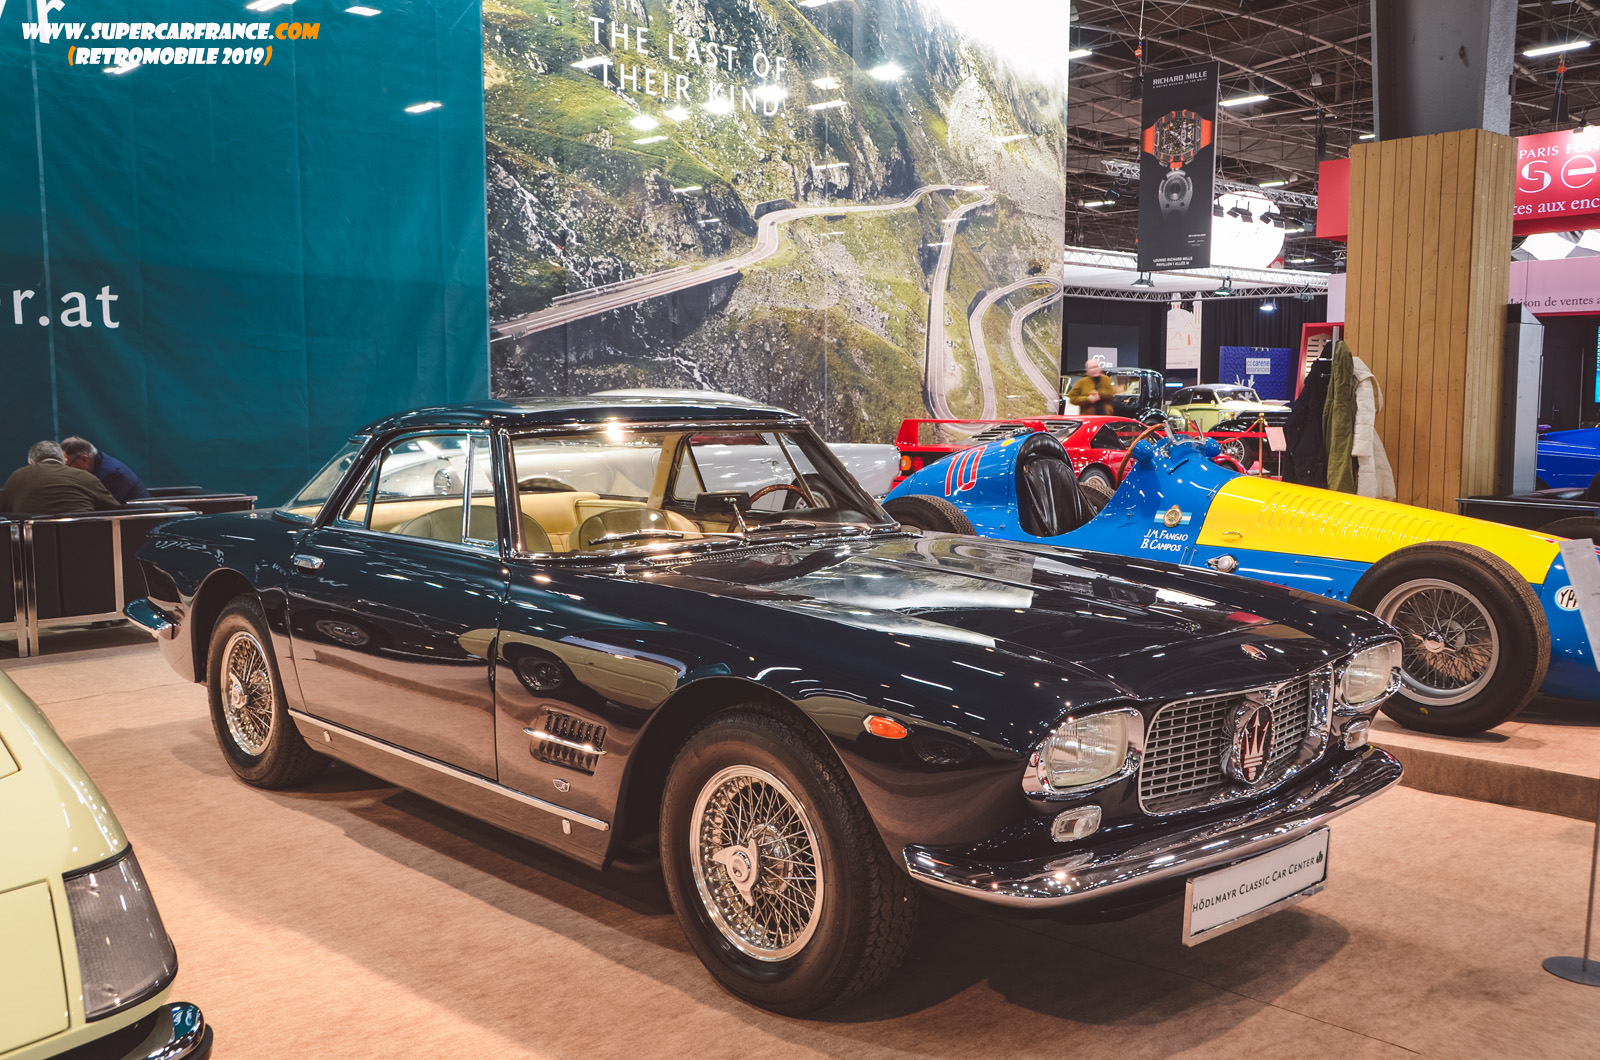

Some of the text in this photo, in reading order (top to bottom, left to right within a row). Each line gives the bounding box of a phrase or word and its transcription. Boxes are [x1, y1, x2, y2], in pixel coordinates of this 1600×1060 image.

[588, 17, 787, 81] THE LAST OF
[600, 61, 691, 101] THEIR
[1153, 75, 1184, 85] RICHARD
[1186, 71, 1207, 80] MILLE
[1519, 145, 1559, 160] PARIS
[1537, 200, 1567, 213] aux
[1544, 296, 1557, 306] de
[1560, 297, 1594, 306] ventes
[944, 445, 988, 497] 10
[1159, 530, 1188, 541] FANGIO
[1149, 540, 1182, 551] CAMPOS
[1192, 856, 1315, 912] HÖDLMAYR CLASSIC CAR CENTER
